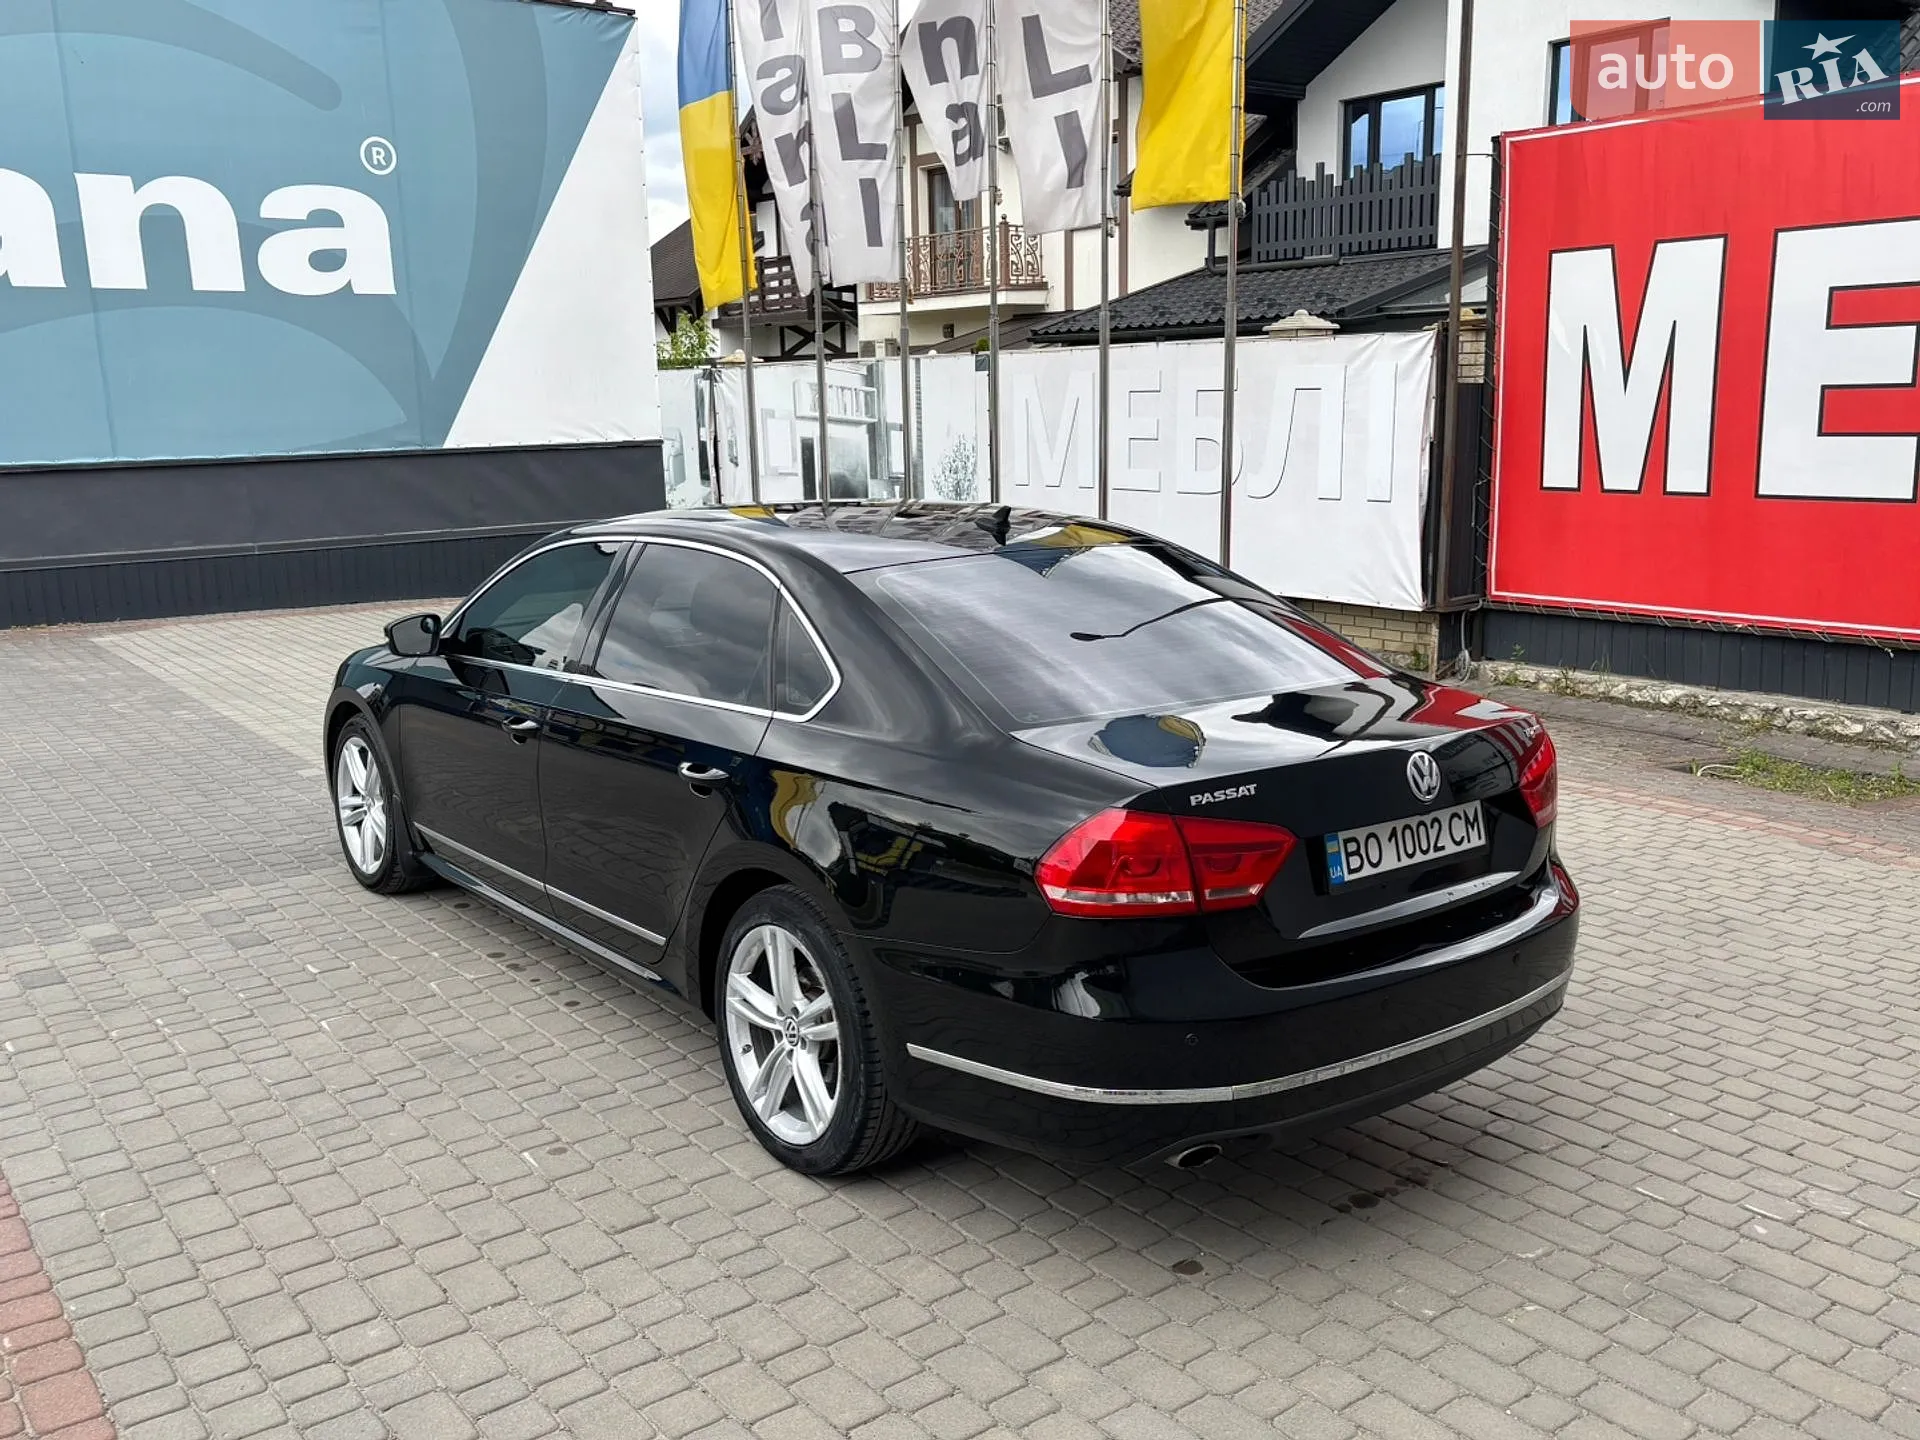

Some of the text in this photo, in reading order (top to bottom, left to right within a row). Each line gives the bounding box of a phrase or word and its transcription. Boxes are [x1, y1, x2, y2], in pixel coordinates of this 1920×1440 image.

[1011, 360, 1399, 503] МЕБЛІ
[1189, 783, 1258, 807] PASSAT
[1342, 805, 1482, 876] BO 1002 CM
